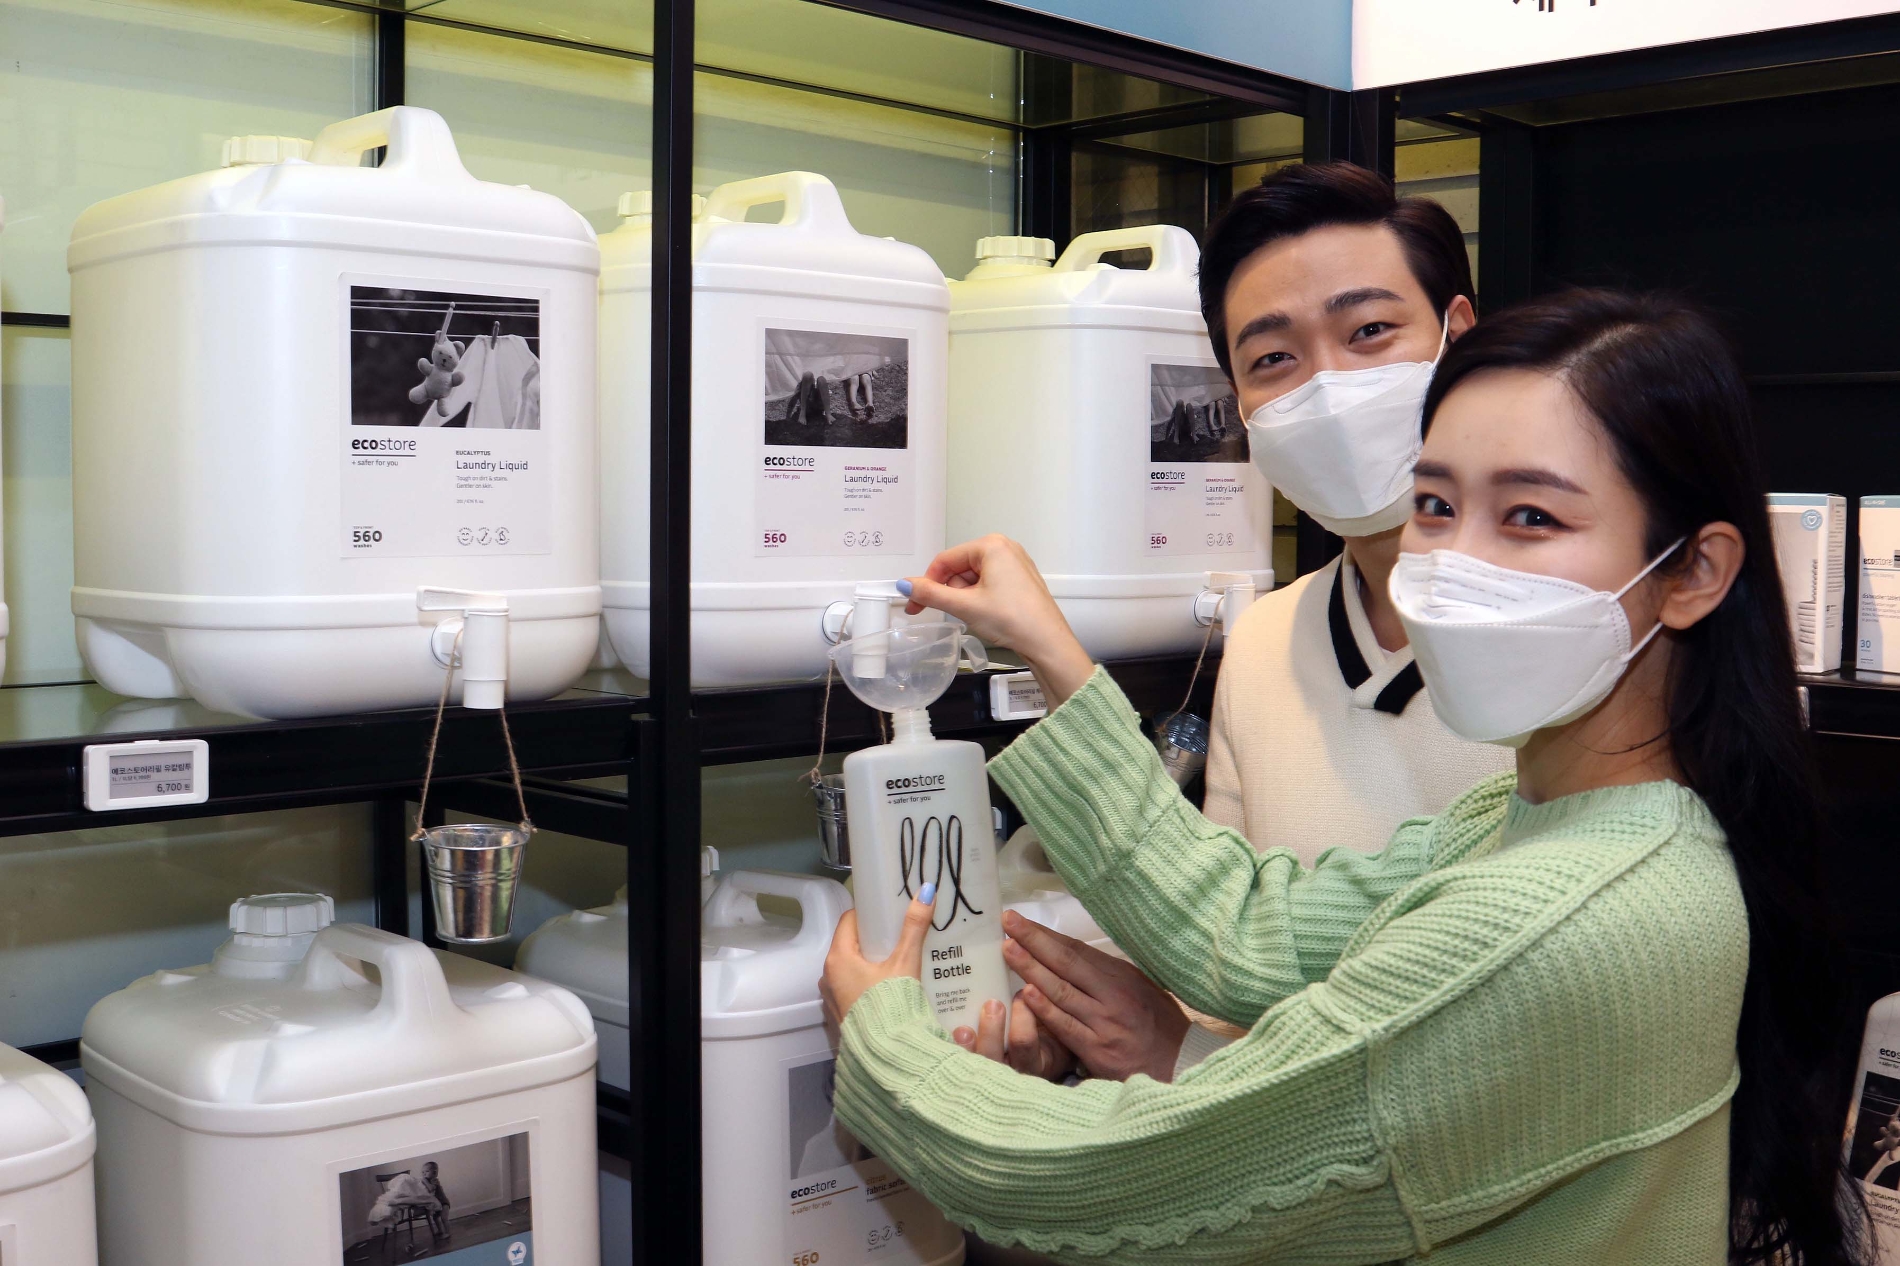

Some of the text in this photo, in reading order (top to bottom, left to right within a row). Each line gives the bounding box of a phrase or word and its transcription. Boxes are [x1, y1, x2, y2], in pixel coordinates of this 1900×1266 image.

[351, 437, 416, 451] ecostore
[386, 460, 399, 468] you
[456, 460, 529, 472] Laundry Liquid
[764, 455, 815, 467] ecostore
[844, 474, 899, 485] Laundry Liquid
[1150, 471, 1186, 480] ecostore
[1205, 485, 1228, 493] Laundry
[353, 530, 383, 543] 560
[764, 533, 787, 543] 560
[1151, 536, 1167, 545] 560
[1860, 639, 1871, 649] 30
[111, 765, 162, 775] 에코스토어리필
[156, 782, 183, 793] 6,700
[885, 774, 945, 790] ecostore
[893, 797, 909, 805] safer
[919, 795, 932, 803] you
[931, 945, 964, 962] Refill
[933, 963, 972, 980] Bottle
[935, 991, 950, 999] Bring
[959, 987, 970, 995] back
[790, 1179, 837, 1199] ecostore
[866, 1183, 887, 1196] fabric
[796, 1204, 812, 1214] safer
[812, 1202, 821, 1210] for
[821, 1199, 833, 1209] you
[792, 1251, 820, 1266] 560
